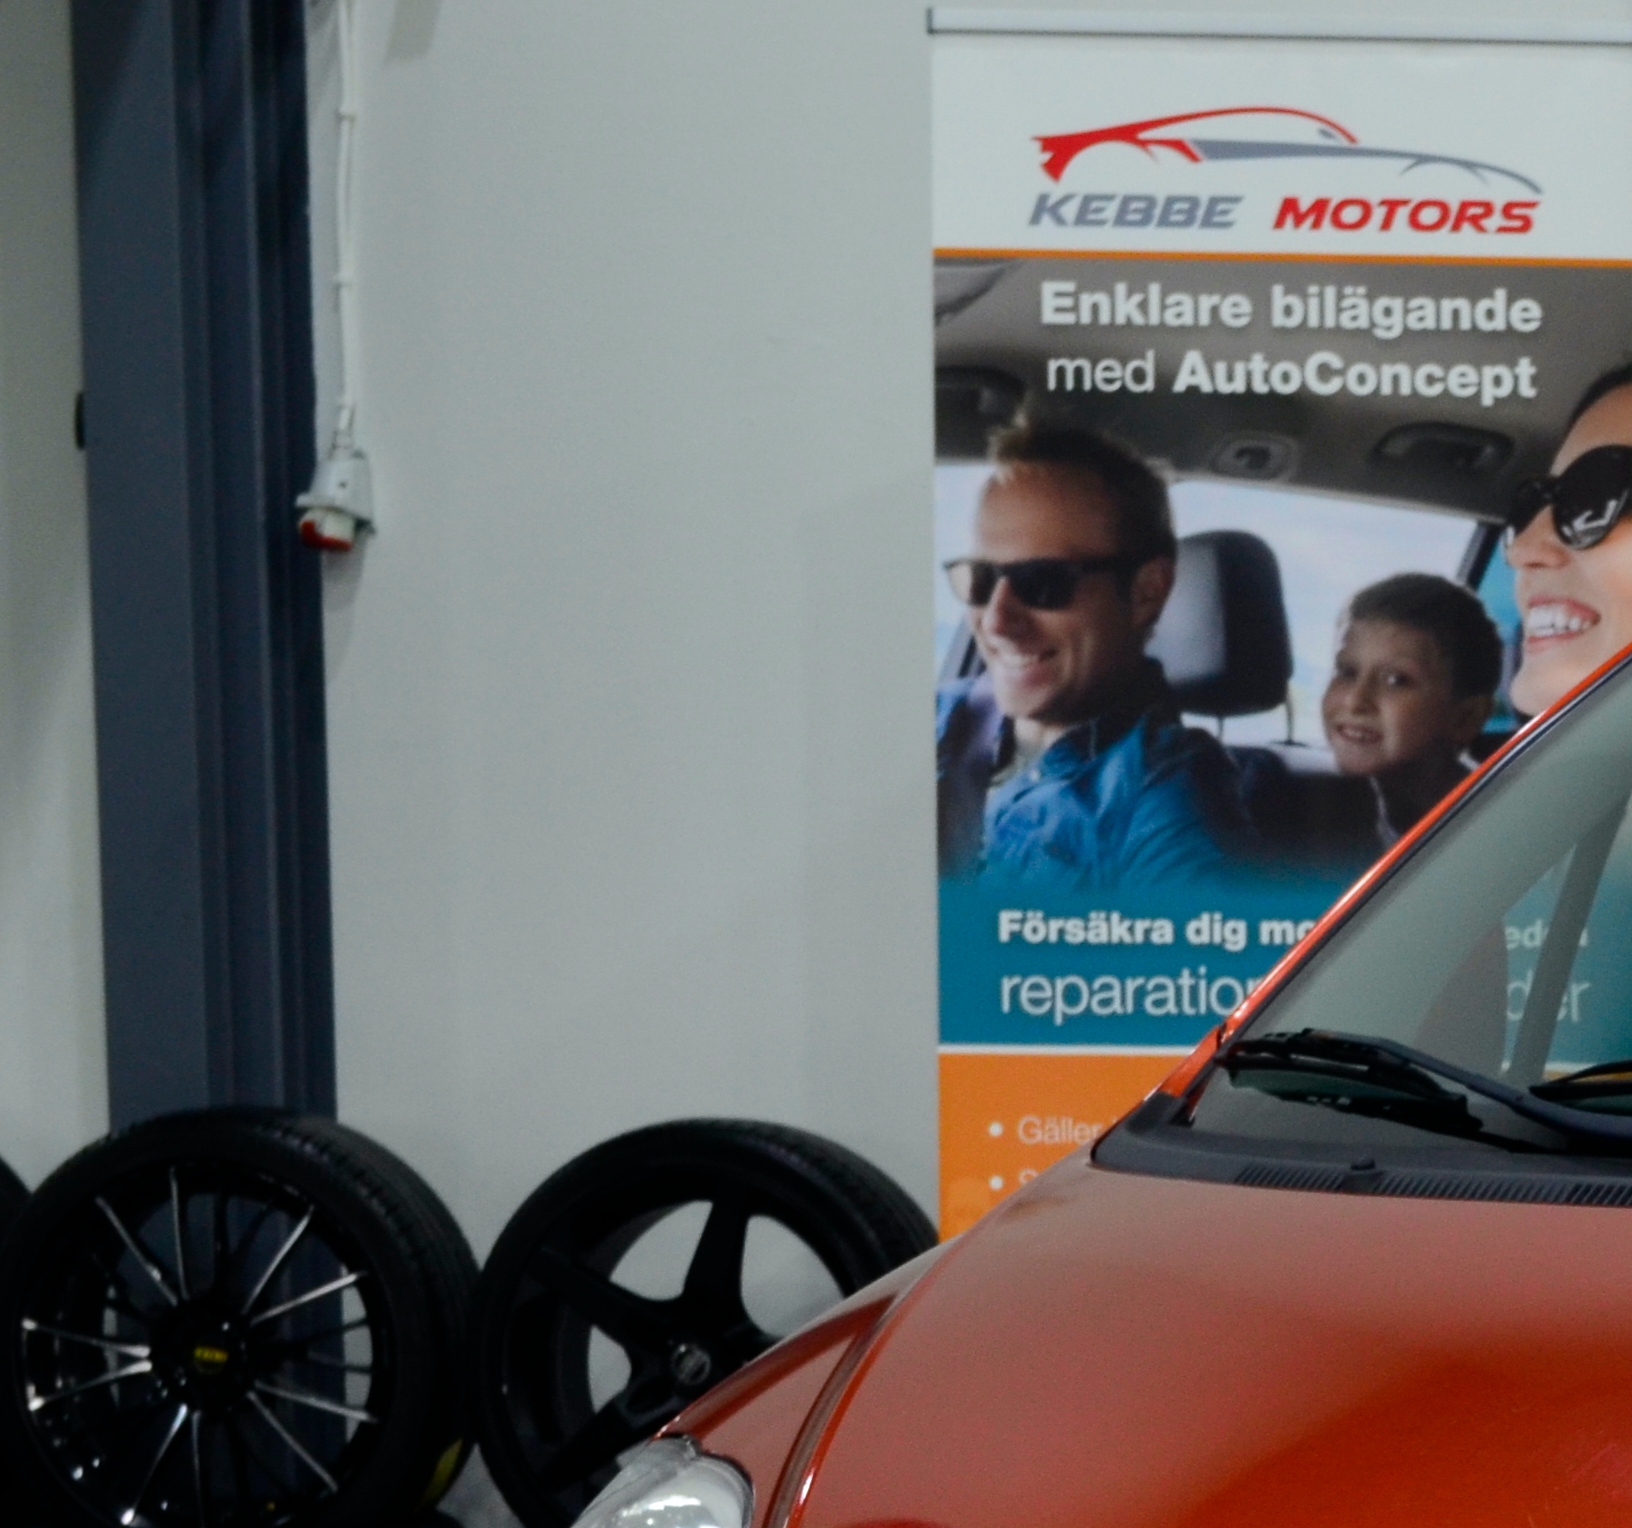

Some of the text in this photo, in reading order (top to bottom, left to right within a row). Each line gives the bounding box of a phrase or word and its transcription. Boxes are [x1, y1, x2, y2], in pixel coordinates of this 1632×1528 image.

[1028, 193, 1543, 235] KEBBE MOTORS
[1040, 280, 1543, 340] Enklare bilägande
[1047, 349, 1538, 407] med AutoConcept
[998, 909, 1175, 945] Försäkra
[1185, 911, 1248, 952] dig
[1018, 1115, 1102, 1145] Gäller
